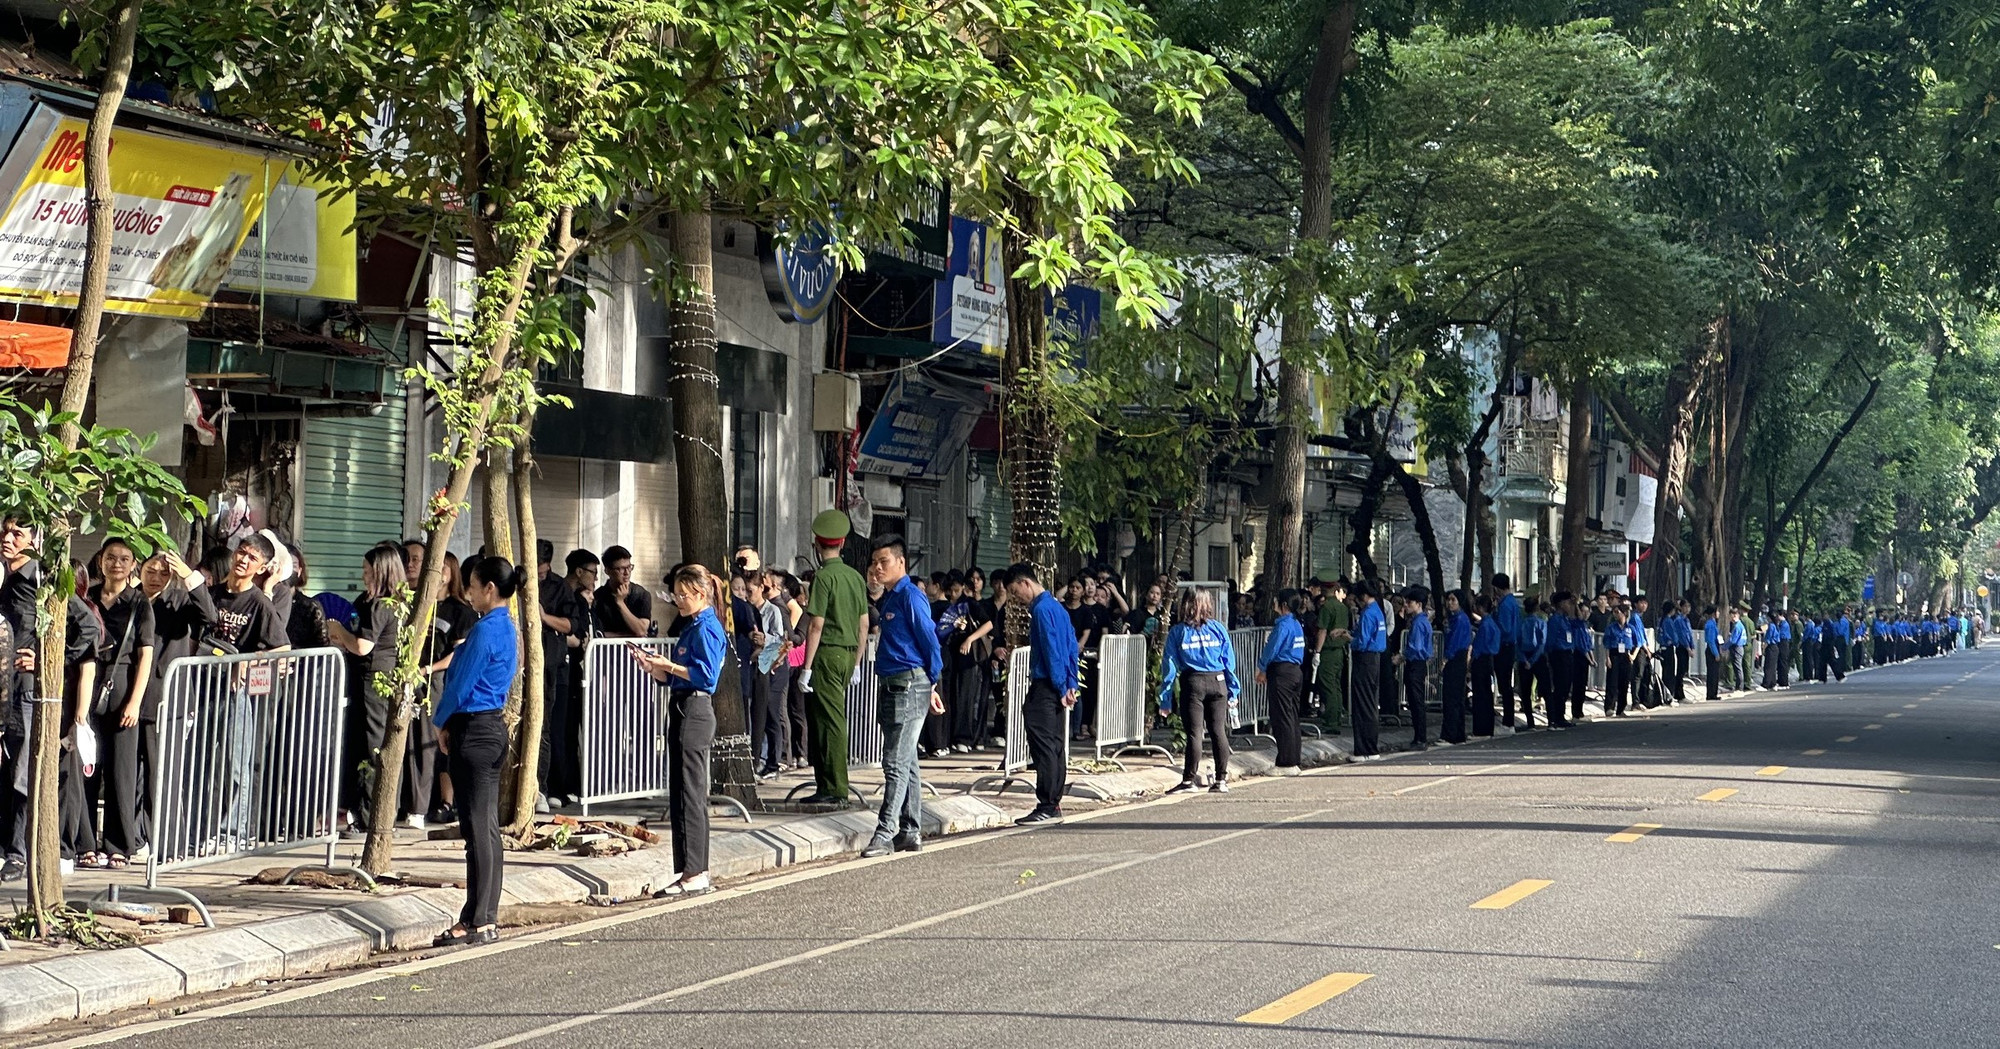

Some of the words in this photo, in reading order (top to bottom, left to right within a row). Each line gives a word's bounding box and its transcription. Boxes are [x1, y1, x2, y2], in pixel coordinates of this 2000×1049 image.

[42, 130, 113, 173] Me
[32, 199, 57, 221] 15
[54, 198, 89, 226] HÙN
[219, 608, 248, 626] vents
